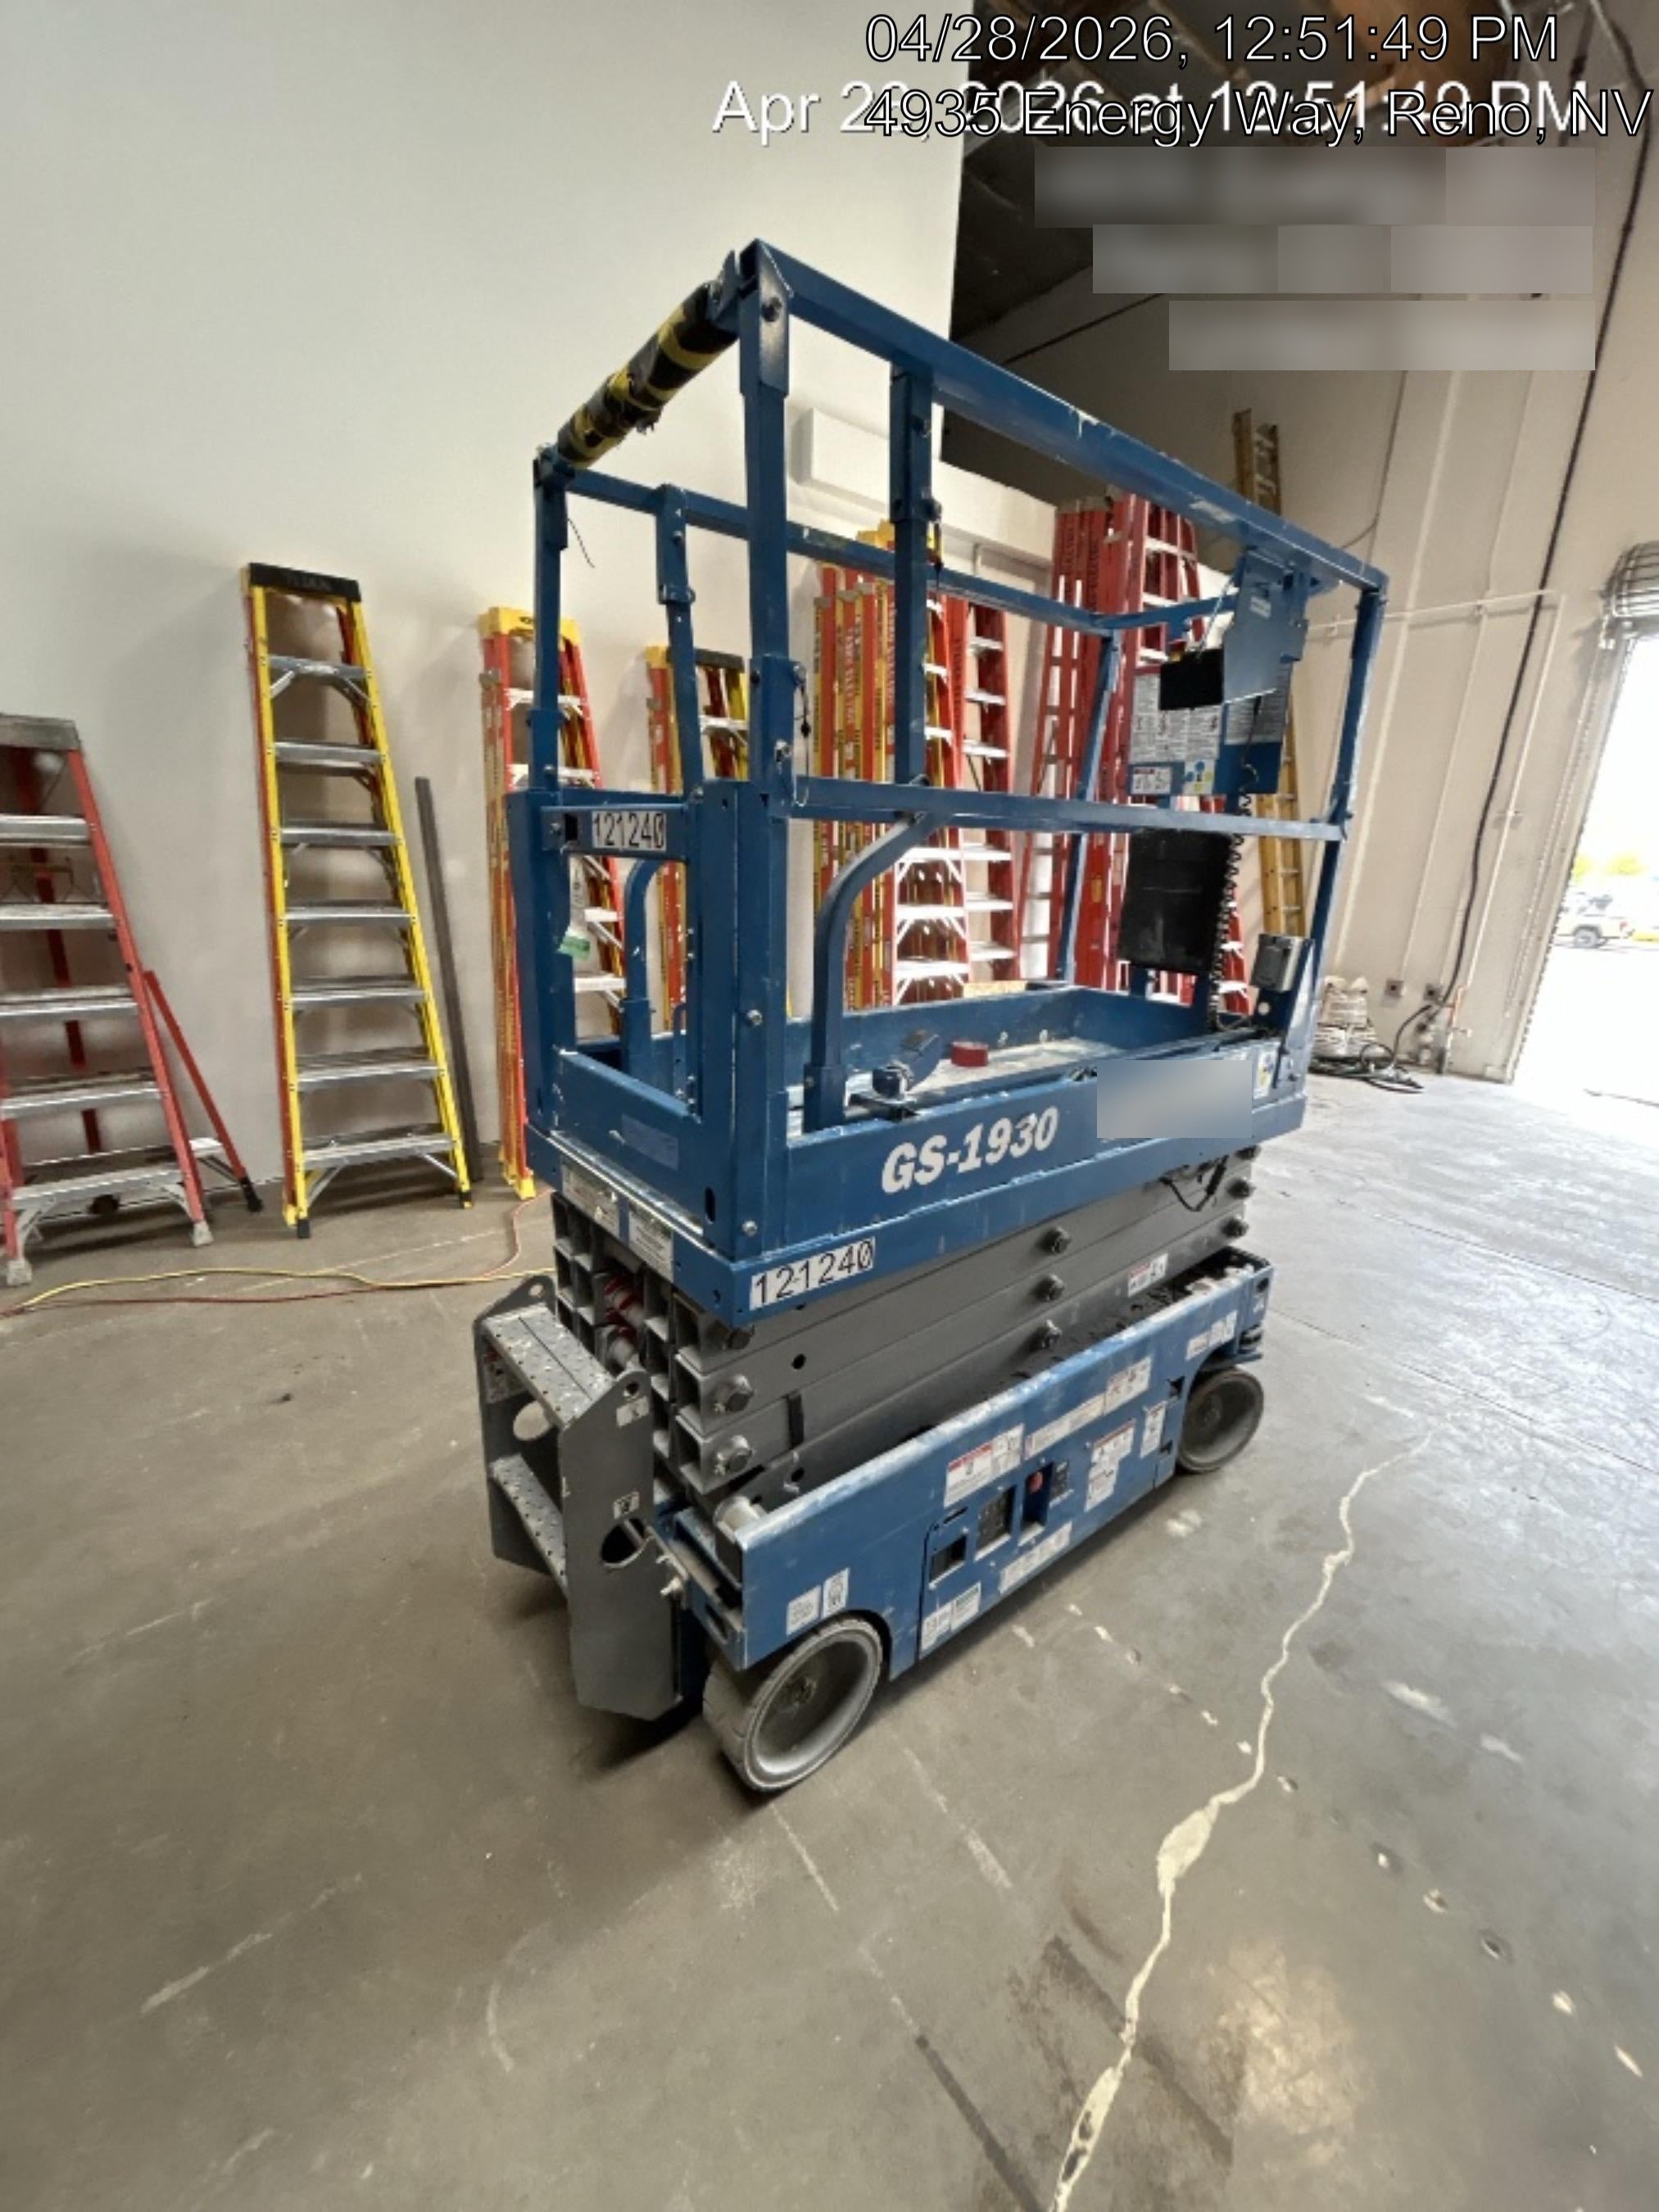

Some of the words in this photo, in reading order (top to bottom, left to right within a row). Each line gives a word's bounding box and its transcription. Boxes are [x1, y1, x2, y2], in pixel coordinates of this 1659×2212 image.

[593, 811, 665, 850] 121240
[881, 1105, 1059, 1195] GS-1930
[754, 1240, 874, 1305] 121240
